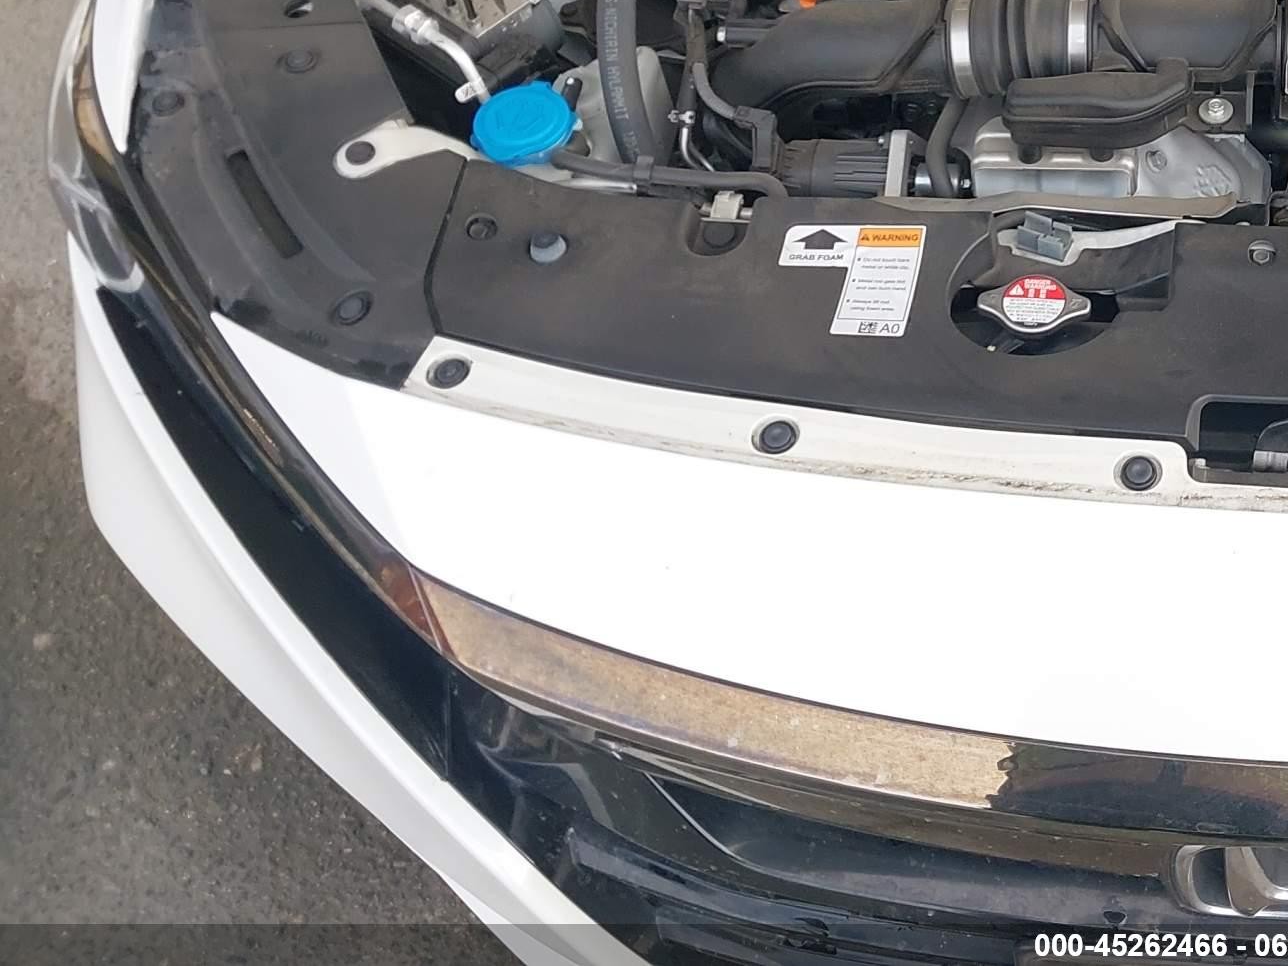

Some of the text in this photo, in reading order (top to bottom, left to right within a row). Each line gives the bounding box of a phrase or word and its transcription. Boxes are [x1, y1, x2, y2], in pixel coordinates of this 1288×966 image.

[872, 233, 919, 242] WARNING
[788, 253, 844, 261] GRAB FOAM
